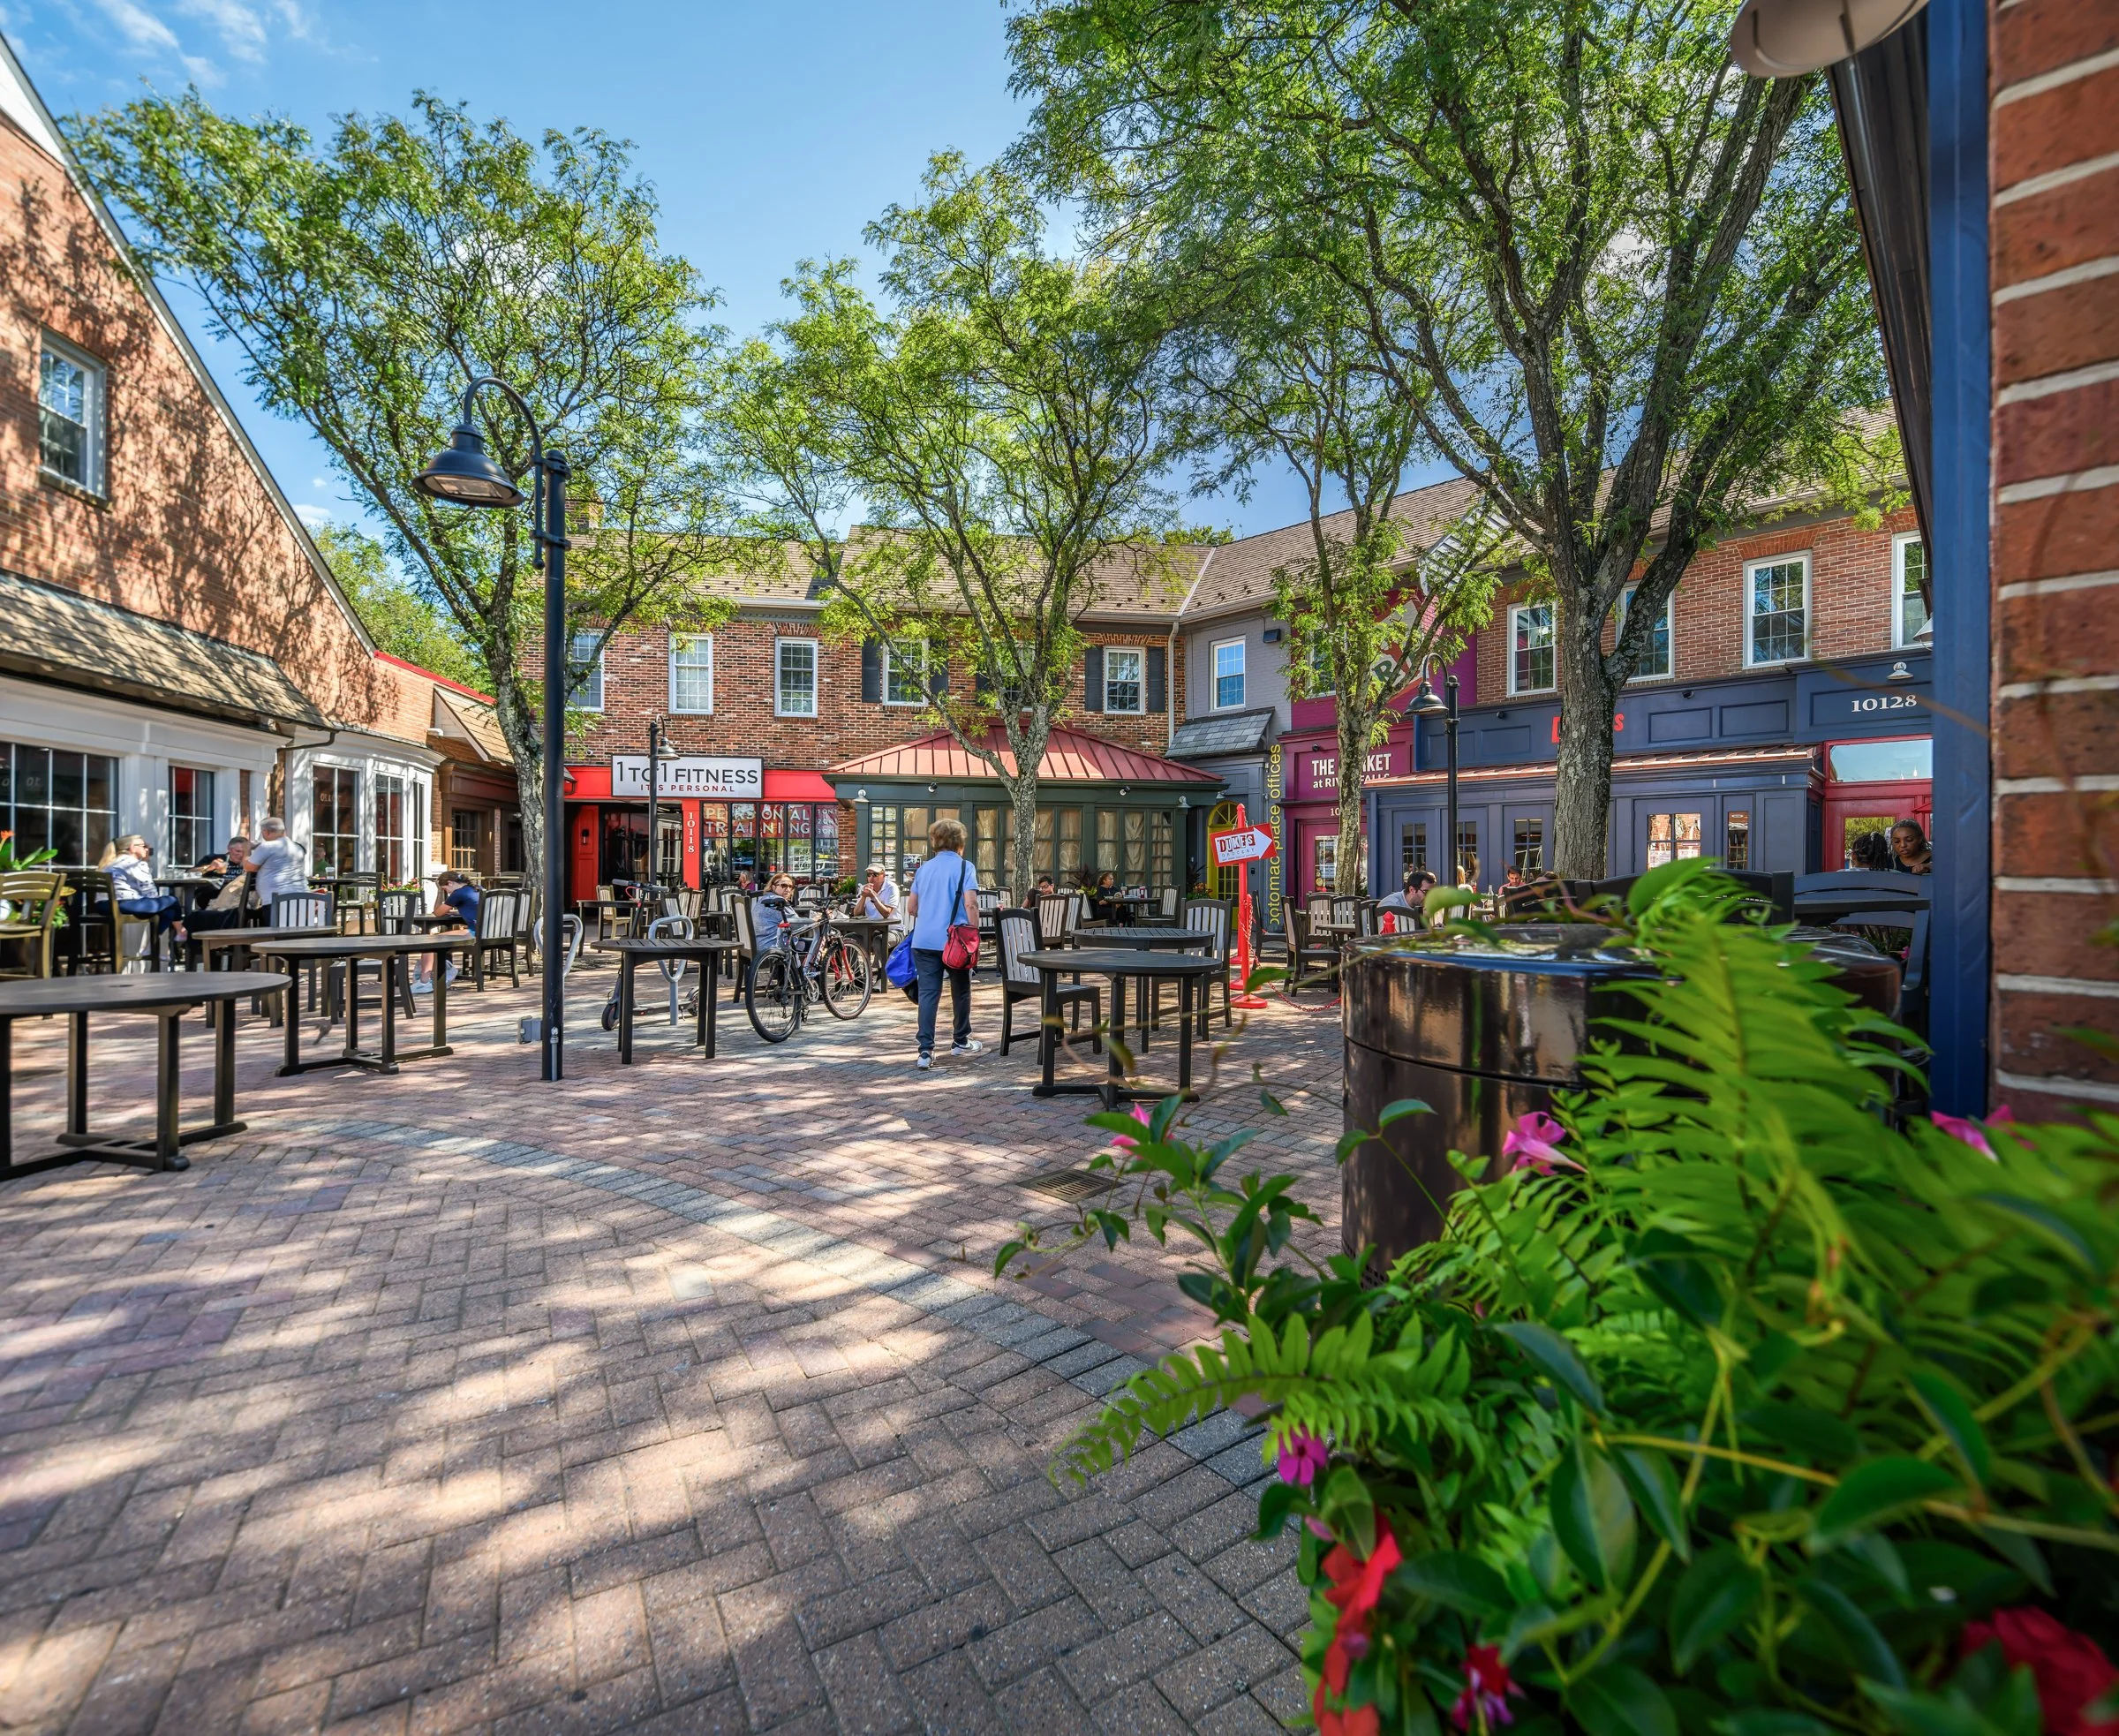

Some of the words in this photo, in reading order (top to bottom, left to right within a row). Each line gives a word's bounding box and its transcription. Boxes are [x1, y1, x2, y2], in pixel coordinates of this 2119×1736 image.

[1851, 694, 1918, 713] 10128
[616, 761, 623, 782] 1
[660, 762, 667, 782] 1
[675, 768, 758, 784] FITNESS
[1268, 743, 1281, 799] offices
[1311, 759, 1335, 776] THE
[1313, 778, 1323, 789] at
[686, 811, 696, 853] 10118
[705, 821, 811, 834] TRAINING
